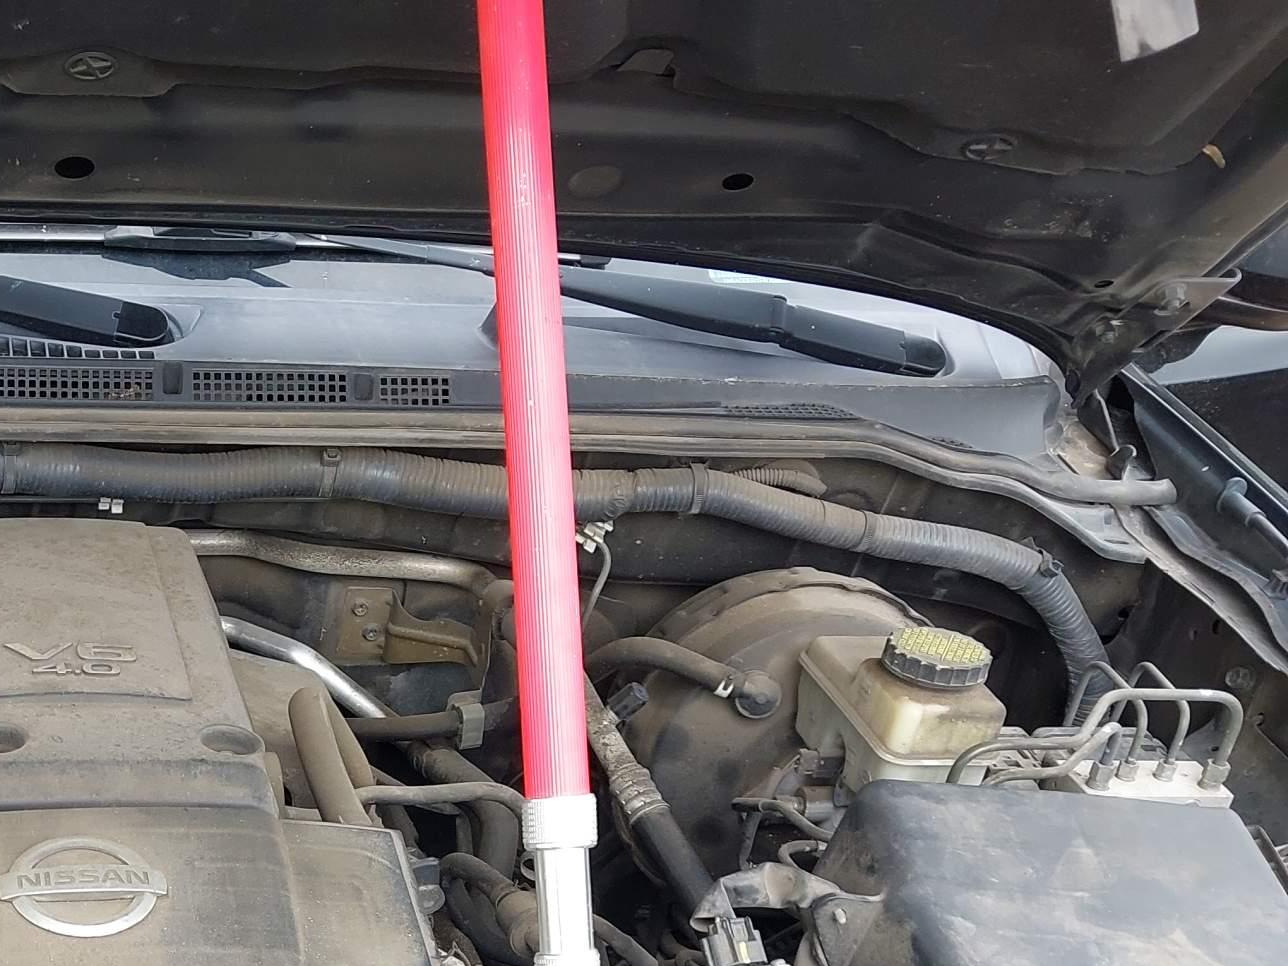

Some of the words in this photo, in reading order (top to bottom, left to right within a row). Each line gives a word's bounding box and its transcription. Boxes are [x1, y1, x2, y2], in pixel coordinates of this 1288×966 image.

[2, 640, 137, 662] V6
[32, 662, 121, 676] 4.0
[16, 869, 150, 889] NISSAN
